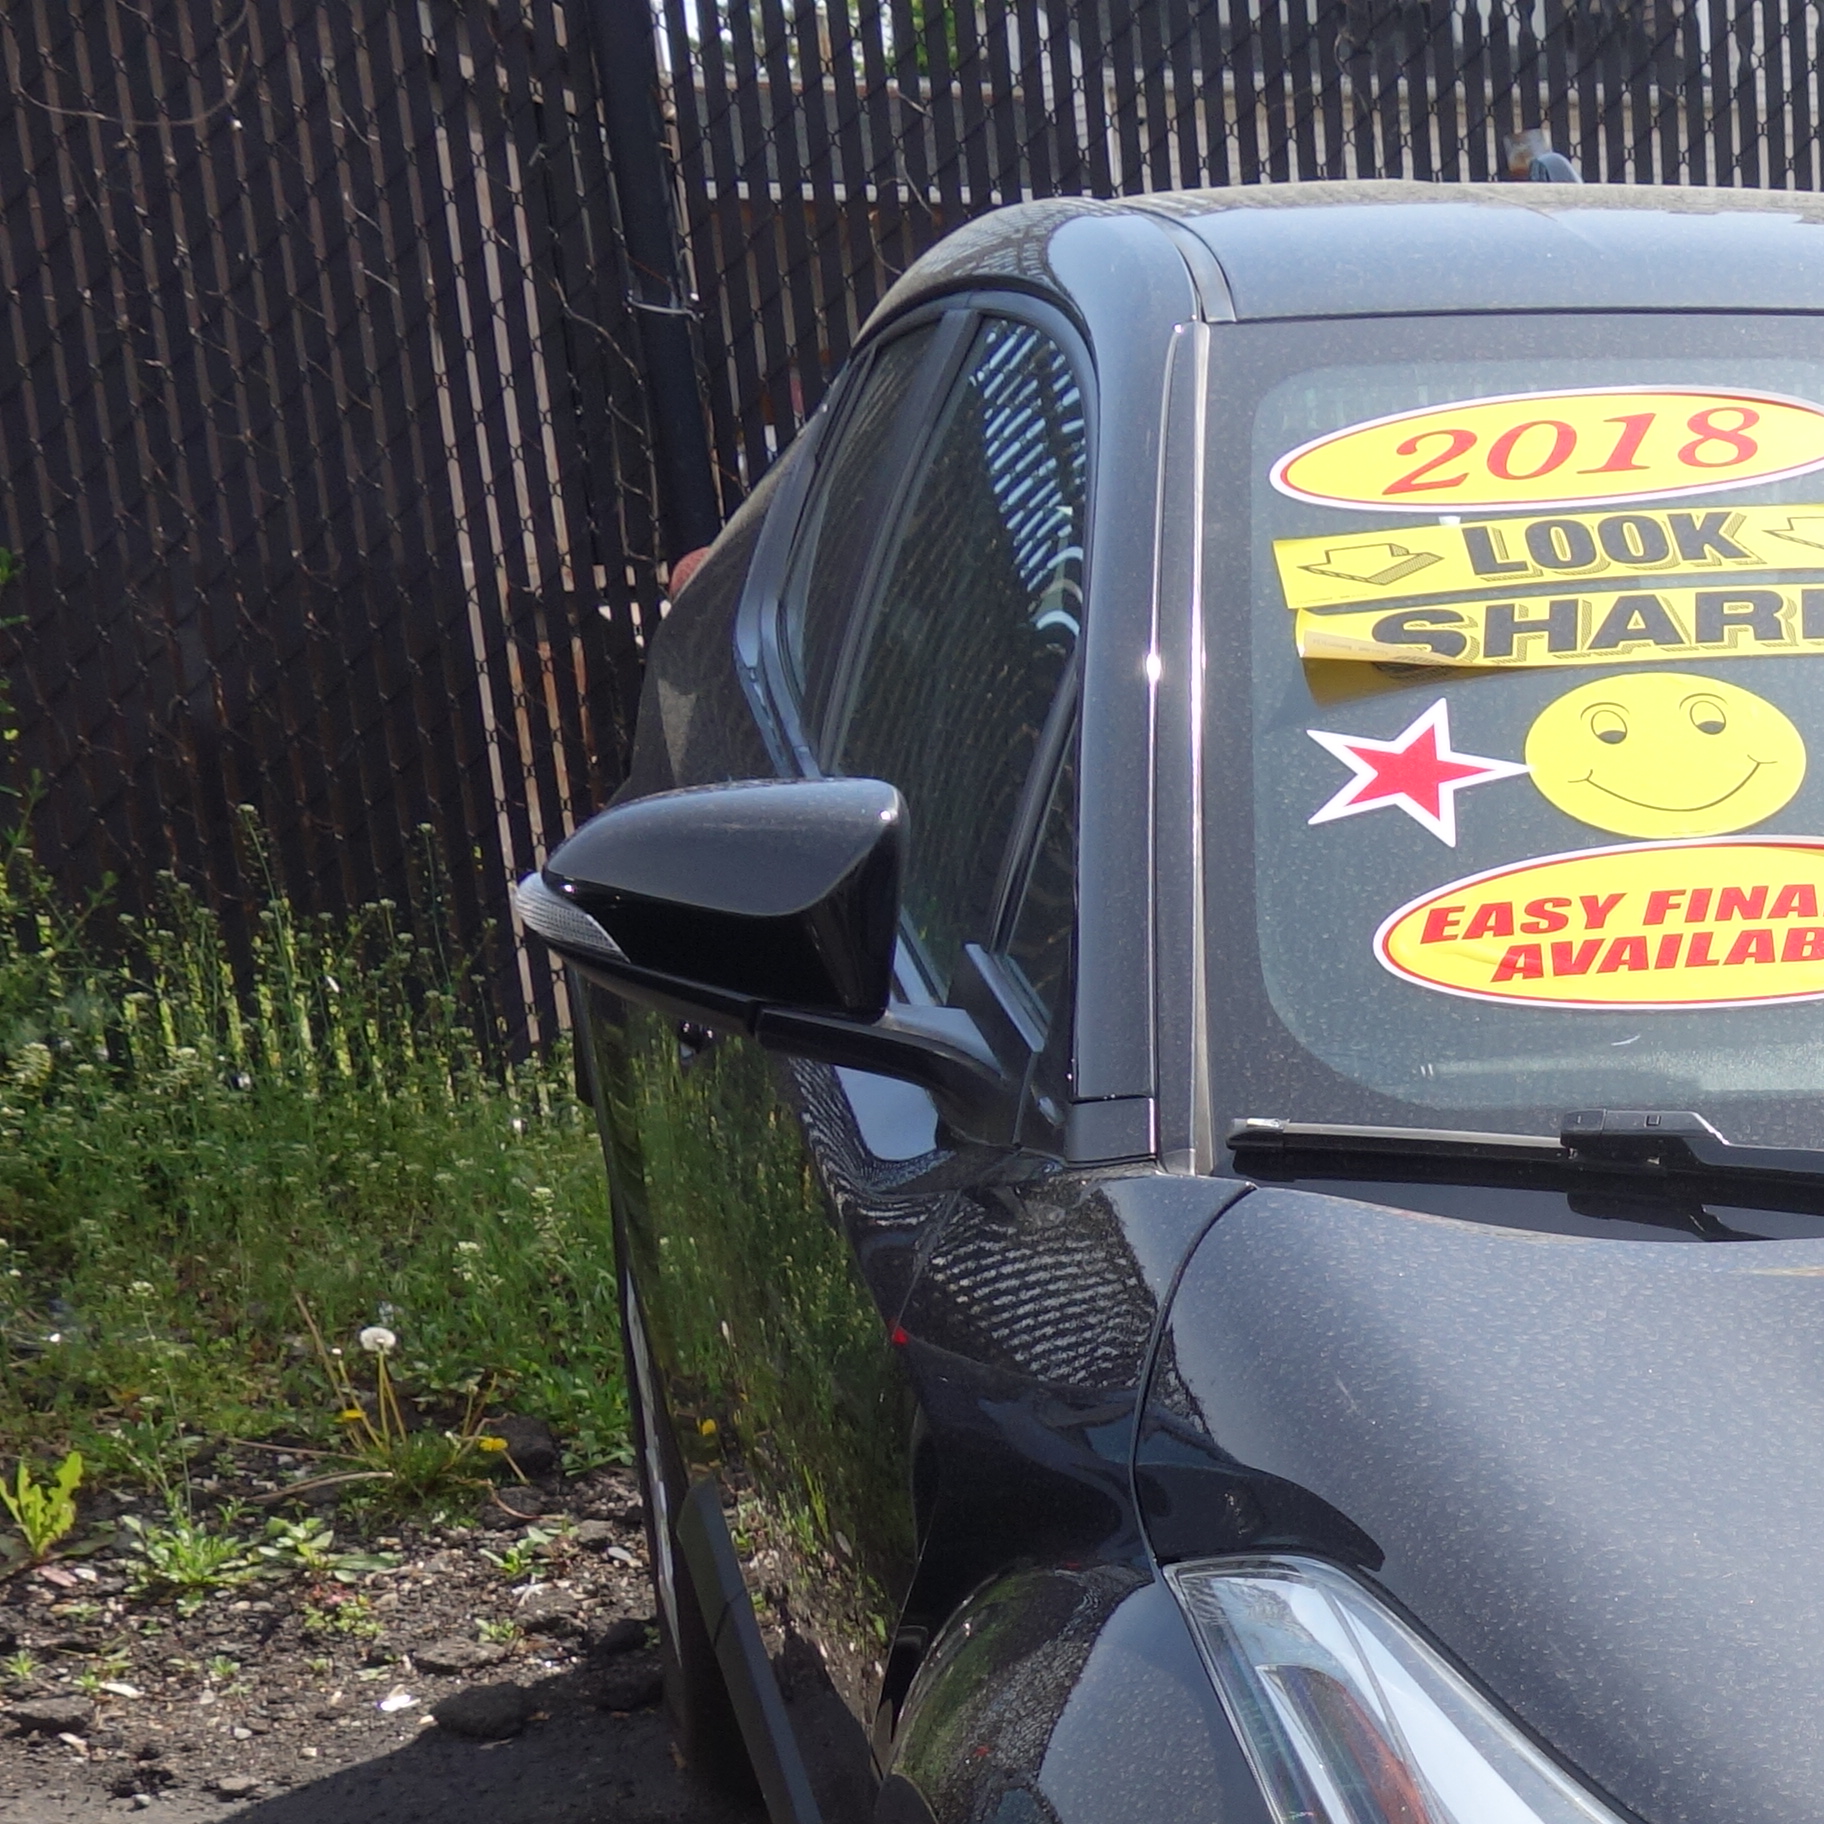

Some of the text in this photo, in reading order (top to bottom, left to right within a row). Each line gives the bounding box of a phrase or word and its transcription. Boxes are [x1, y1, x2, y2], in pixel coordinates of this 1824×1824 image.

[1382, 406, 1761, 497] 2018
[1461, 509, 1762, 581] LOOK
[1418, 891, 1628, 945] EASY
